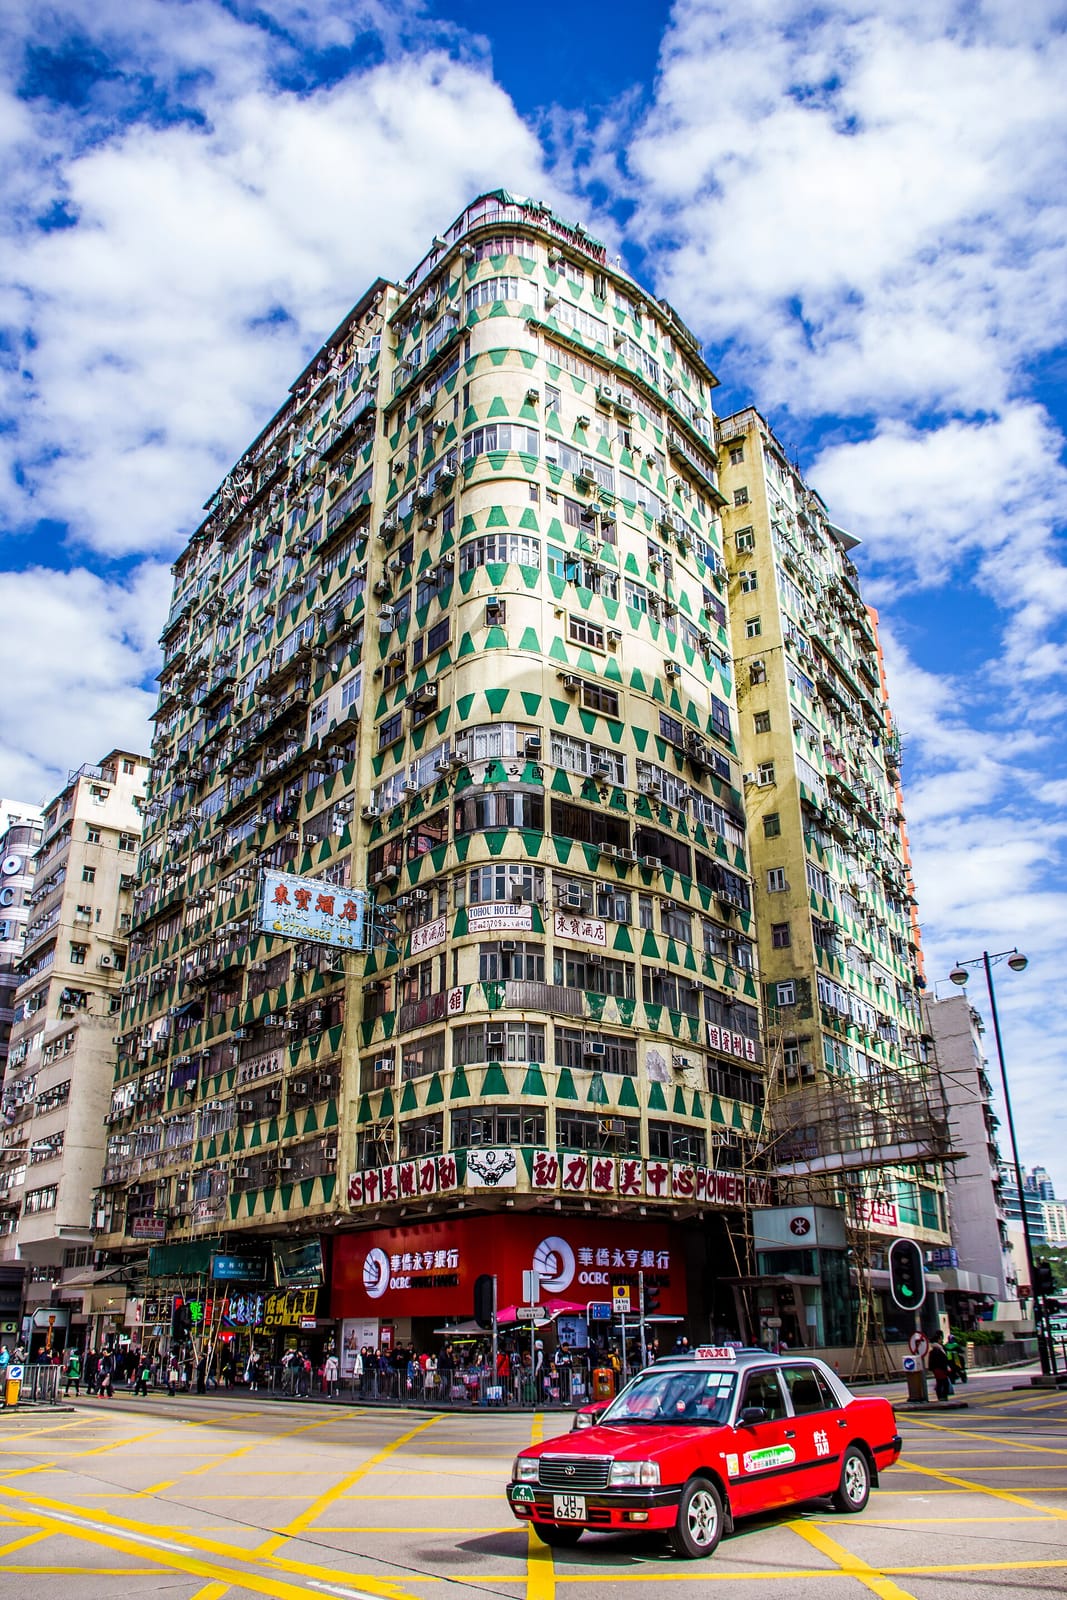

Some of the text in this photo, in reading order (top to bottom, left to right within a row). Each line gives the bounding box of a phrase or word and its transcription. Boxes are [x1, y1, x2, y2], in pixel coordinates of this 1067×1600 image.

[270, 883, 358, 921] 東寶酒店
[276, 904, 352, 930] TOHOU HOTEL
[470, 905, 519, 918] TOHOU HOTEL
[556, 915, 605, 941] 東寶酒店
[449, 988, 462, 1010] 館
[532, 1152, 695, 1196] 動力健美中心
[696, 1169, 744, 1203] POWER
[390, 1249, 459, 1272] 華僑永亨銀行
[577, 1247, 670, 1270] 華僑永亨銀行
[390, 1276, 411, 1290] OCBC
[578, 1271, 609, 1285] OCBC
[698, 1348, 729, 1358] TAXI
[813, 1429, 828, 1443] 的士
[815, 1442, 830, 1456] TAXI
[519, 1488, 525, 1497] 4
[562, 1496, 576, 1507] UH
[556, 1506, 584, 1519] 6457
